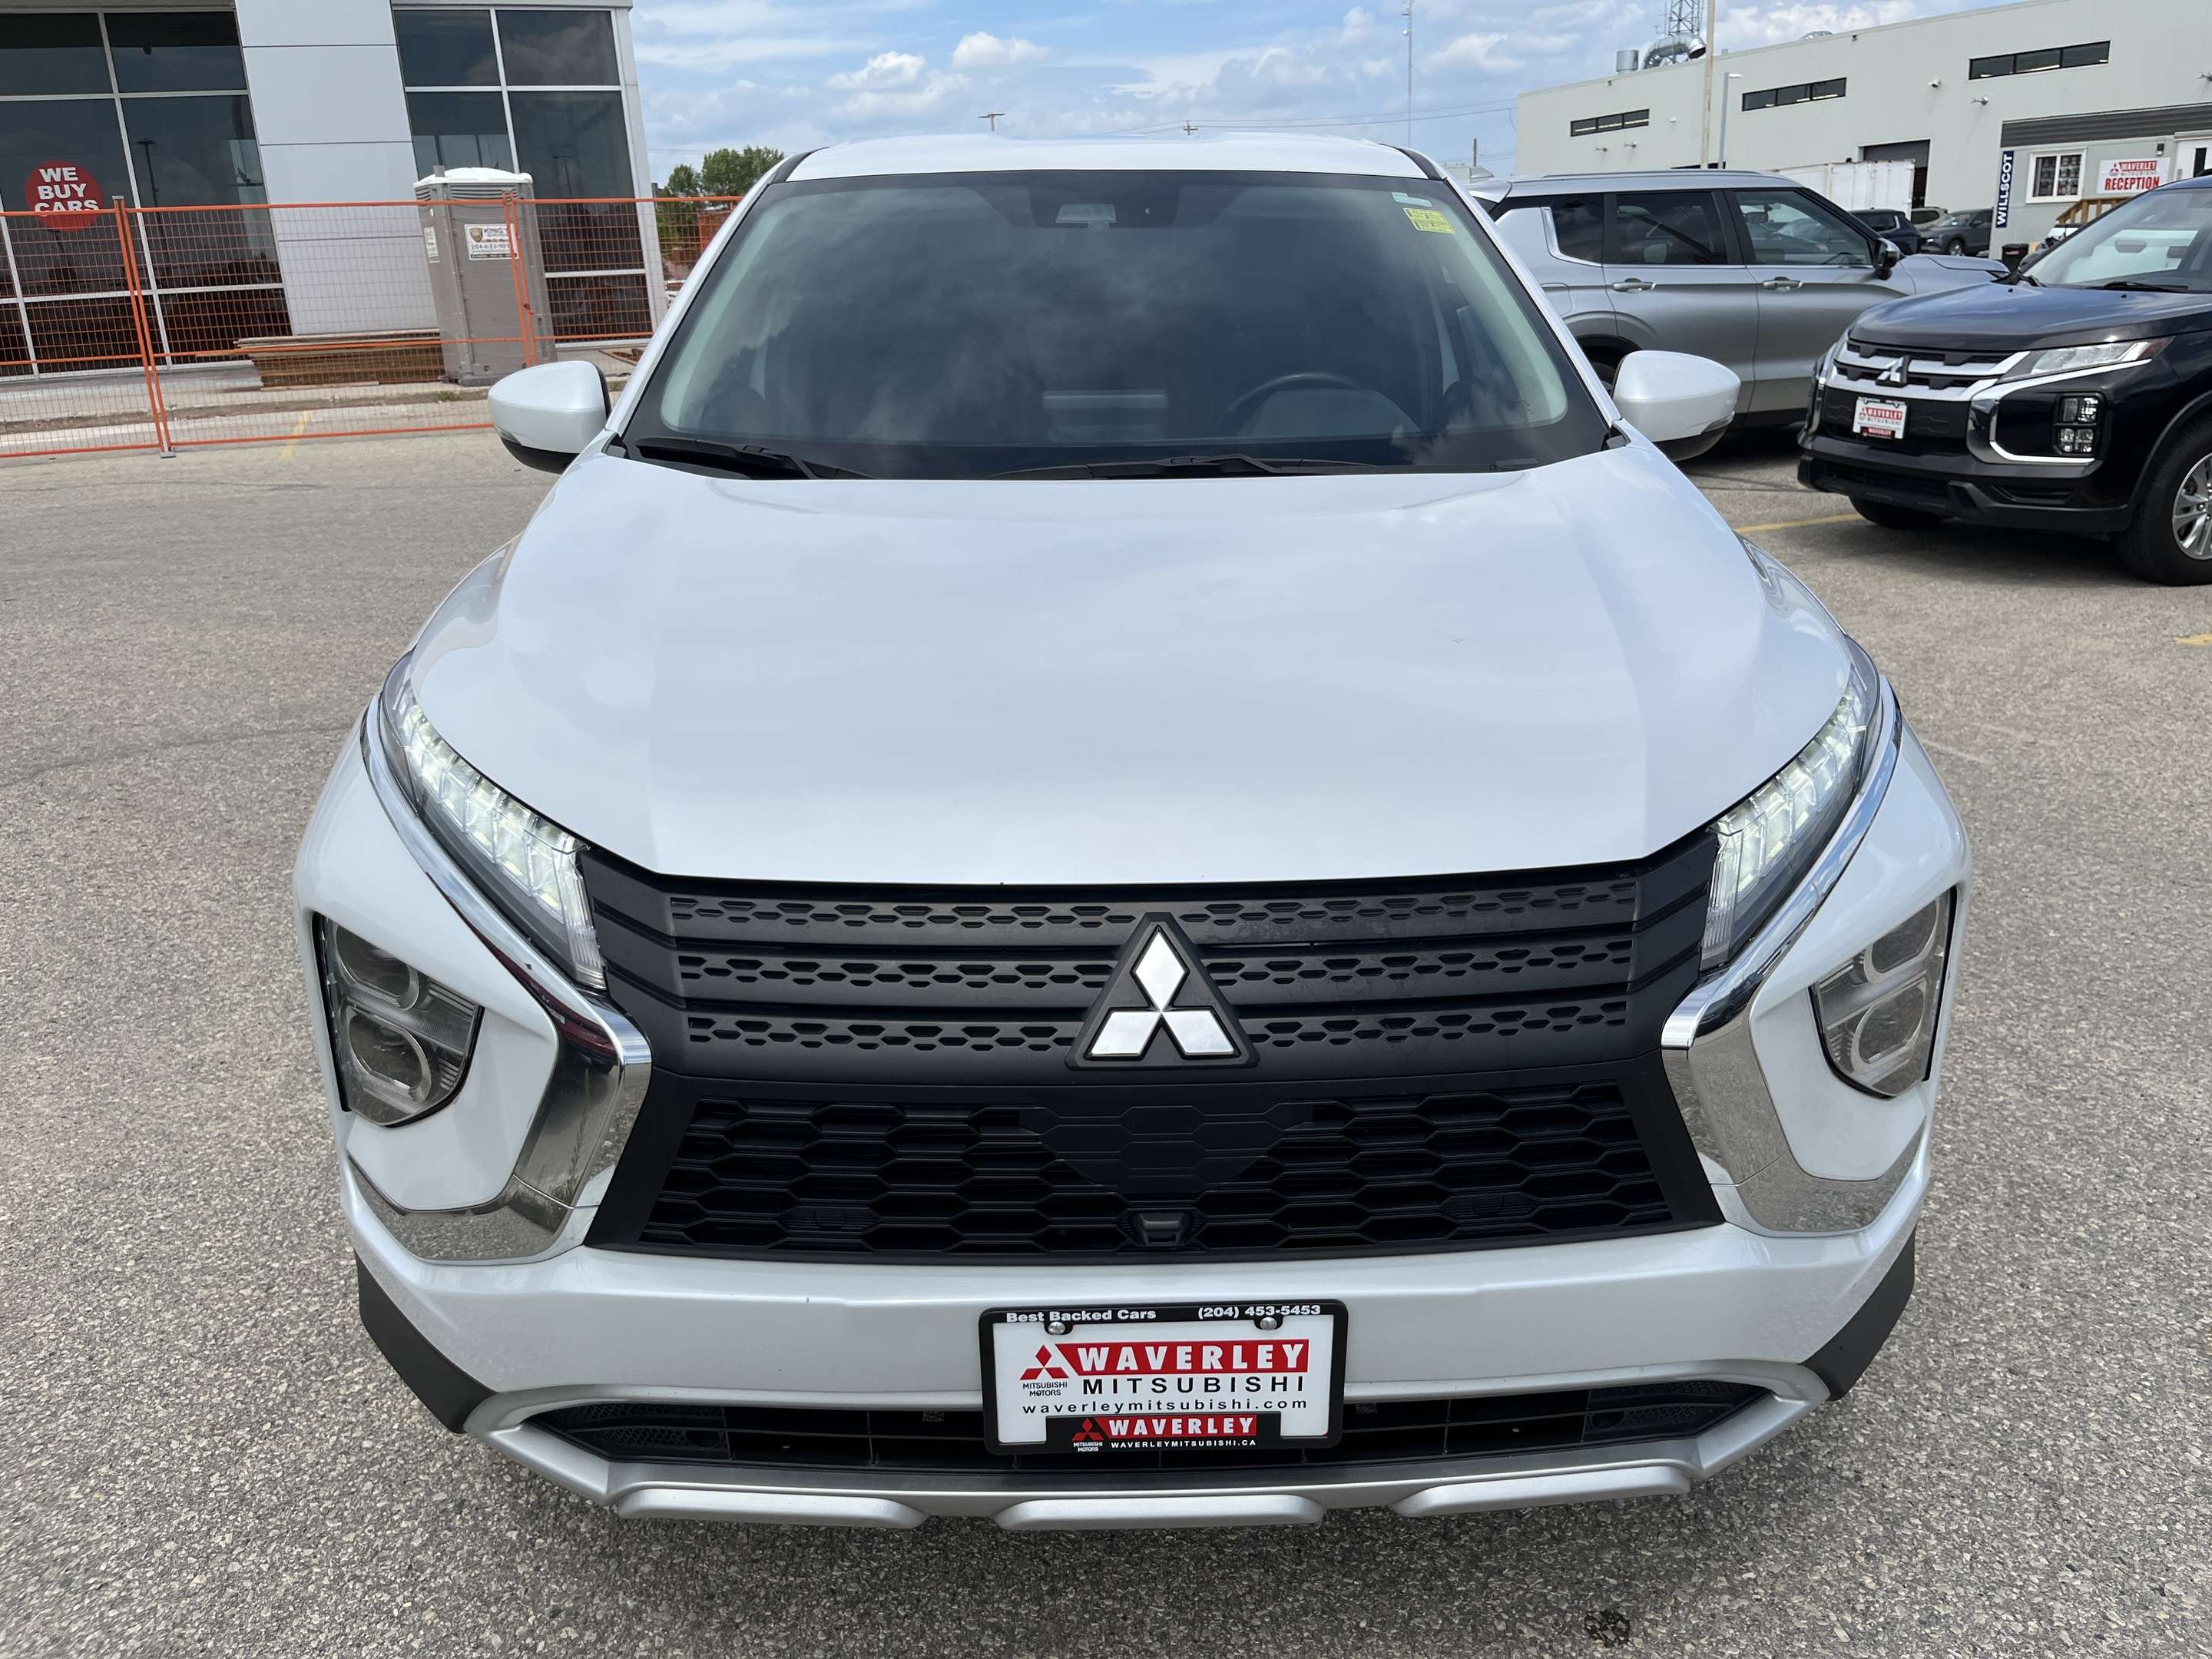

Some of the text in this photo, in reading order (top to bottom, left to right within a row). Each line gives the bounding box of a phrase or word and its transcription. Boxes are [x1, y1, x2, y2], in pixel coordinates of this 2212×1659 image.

[39, 167, 78, 183] WE
[2104, 177, 2160, 190] RECEPTION
[37, 183, 87, 200] BUY
[1997, 153, 2013, 226] WILLSCOT
[35, 199, 99, 217] CARS
[1006, 1304, 1321, 1323] Best Backed Cars (204) 453-5453
[1077, 1343, 1304, 1373] WAVERLEY
[1022, 1381, 1068, 1389] MITSUBISHI
[1082, 1376, 1303, 1395] MITSUBISHI
[1022, 1398, 1307, 1414] waverleymitsubishi.com
[1108, 1417, 1253, 1436] WAVERLEY
[1111, 1439, 1256, 1449] WAVERLEYMITSUBISHI.CA
